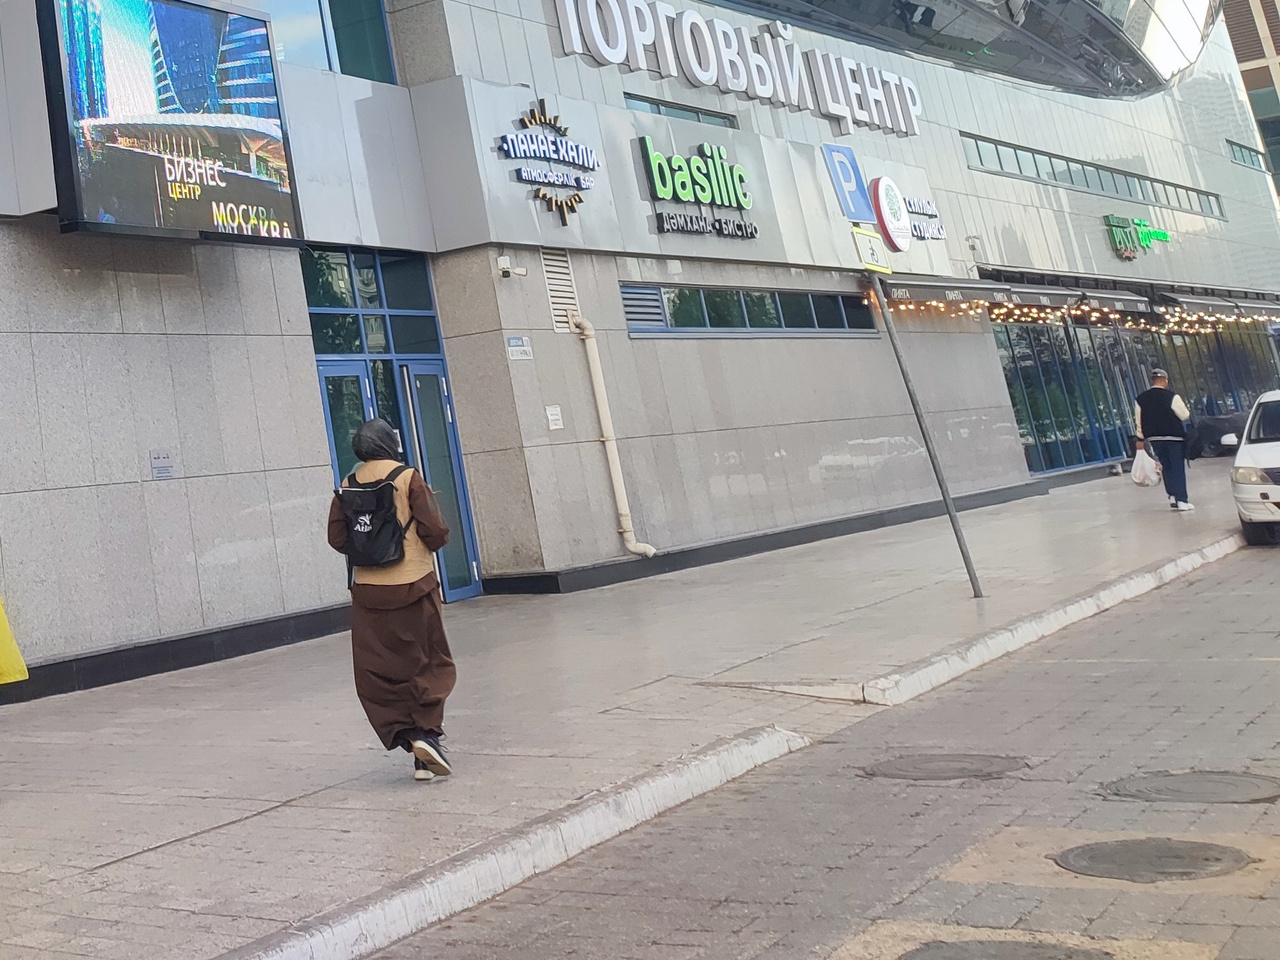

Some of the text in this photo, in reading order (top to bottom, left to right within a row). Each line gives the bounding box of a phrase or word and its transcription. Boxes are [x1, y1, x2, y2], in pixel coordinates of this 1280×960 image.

[808, 48, 922, 137] ЦЕНТР
[506, 133, 597, 171] ПАНАЕХАЛИ
[164, 157, 227, 188] БИЗНЕС
[580, 176, 595, 189] БАР
[641, 135, 753, 211] basilic
[167, 181, 201, 201] ЦЕНТР
[663, 212, 760, 239] ДӘМХАНА БИСТРО
